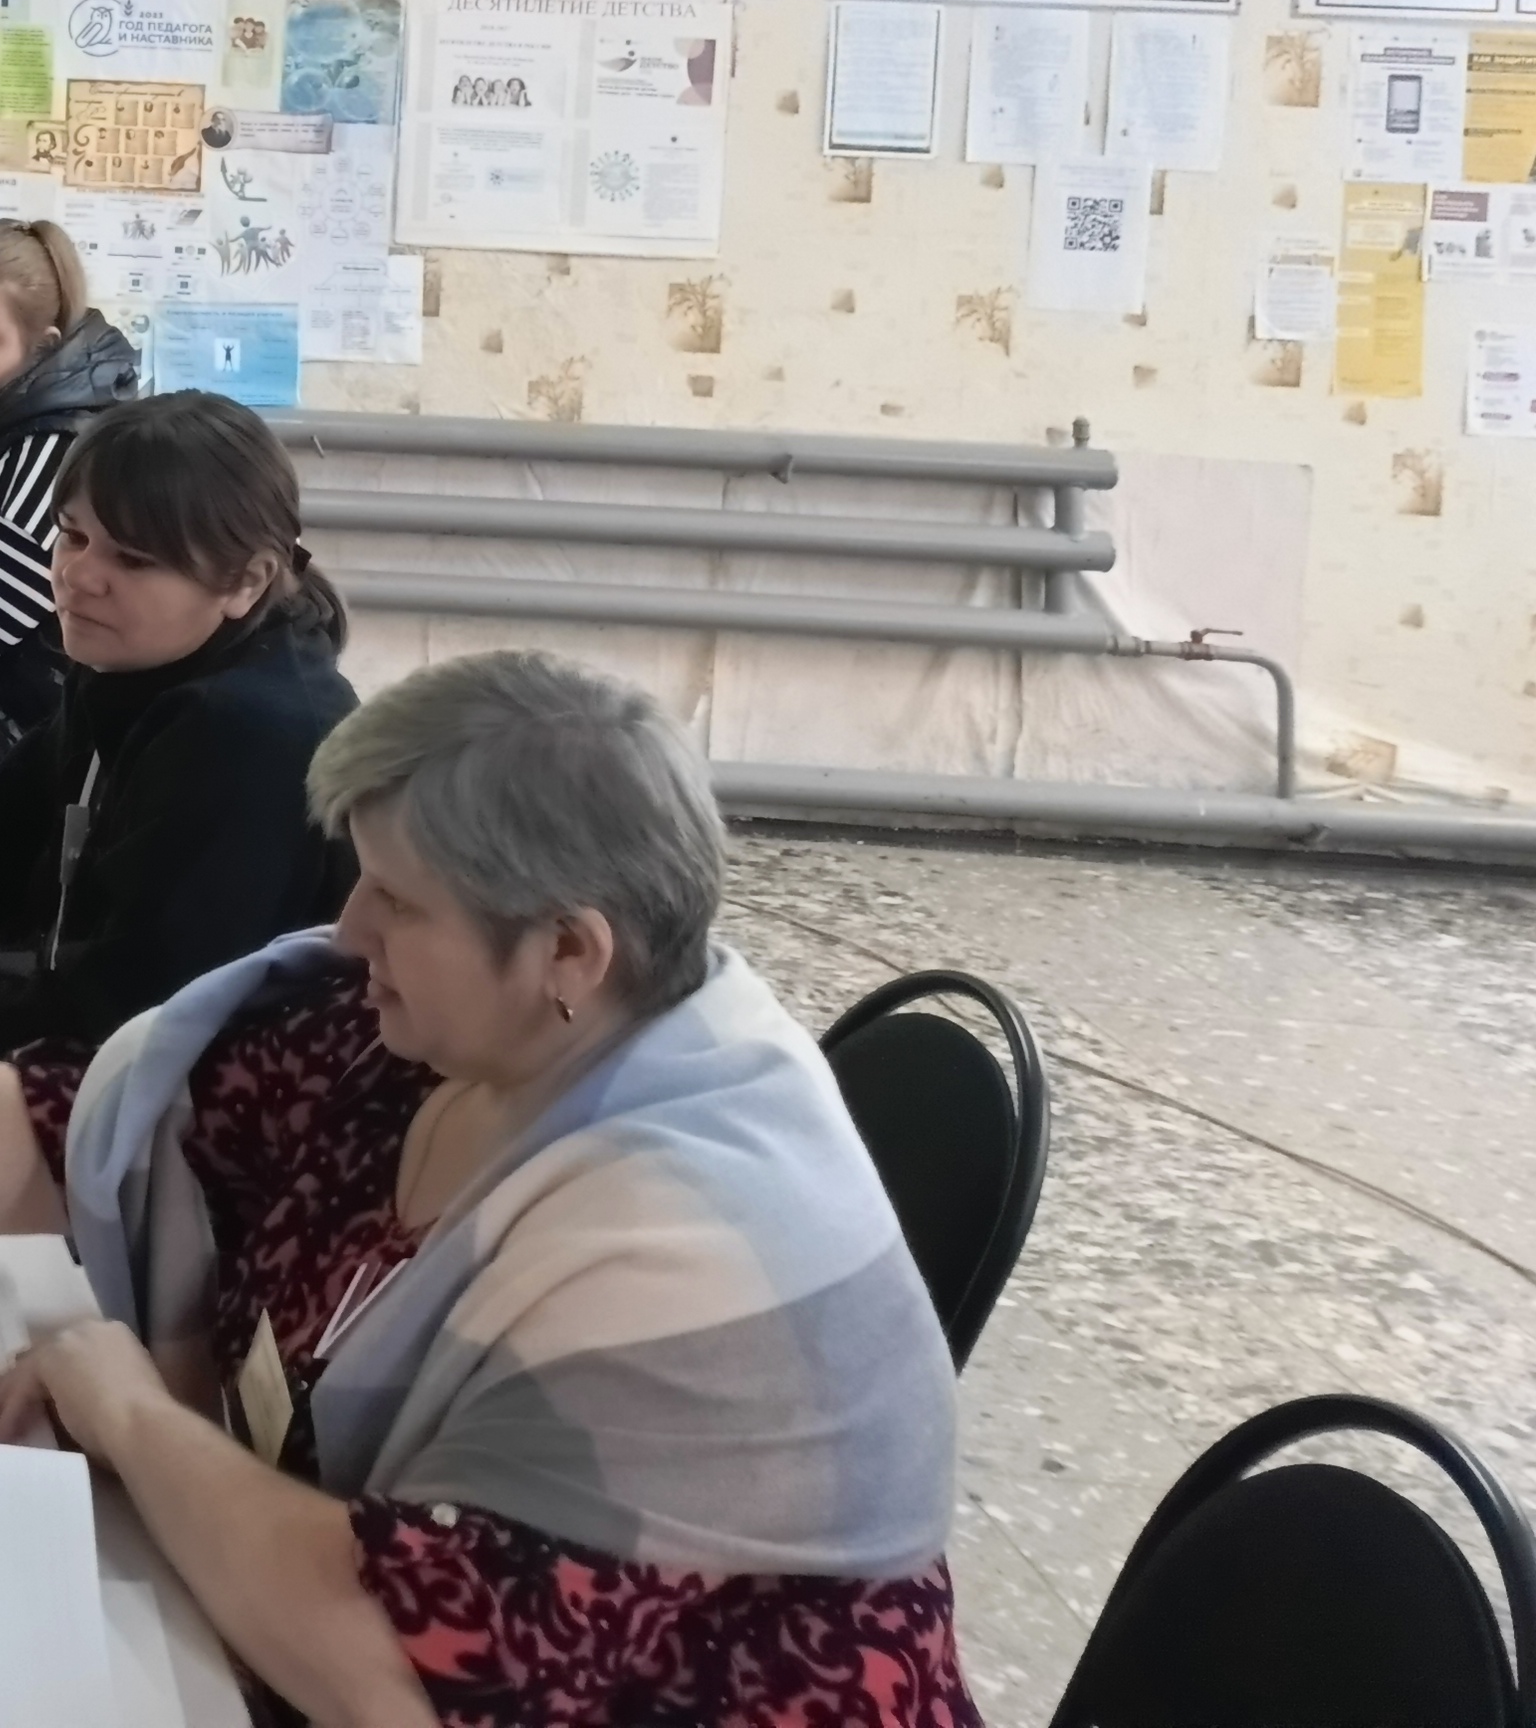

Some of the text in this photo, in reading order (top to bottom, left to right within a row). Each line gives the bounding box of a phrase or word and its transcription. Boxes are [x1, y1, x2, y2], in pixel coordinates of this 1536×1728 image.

[119, 20, 213, 34] ГОД ПЕДАГОГА
[118, 33, 214, 46] И НАСТАВНИКА
